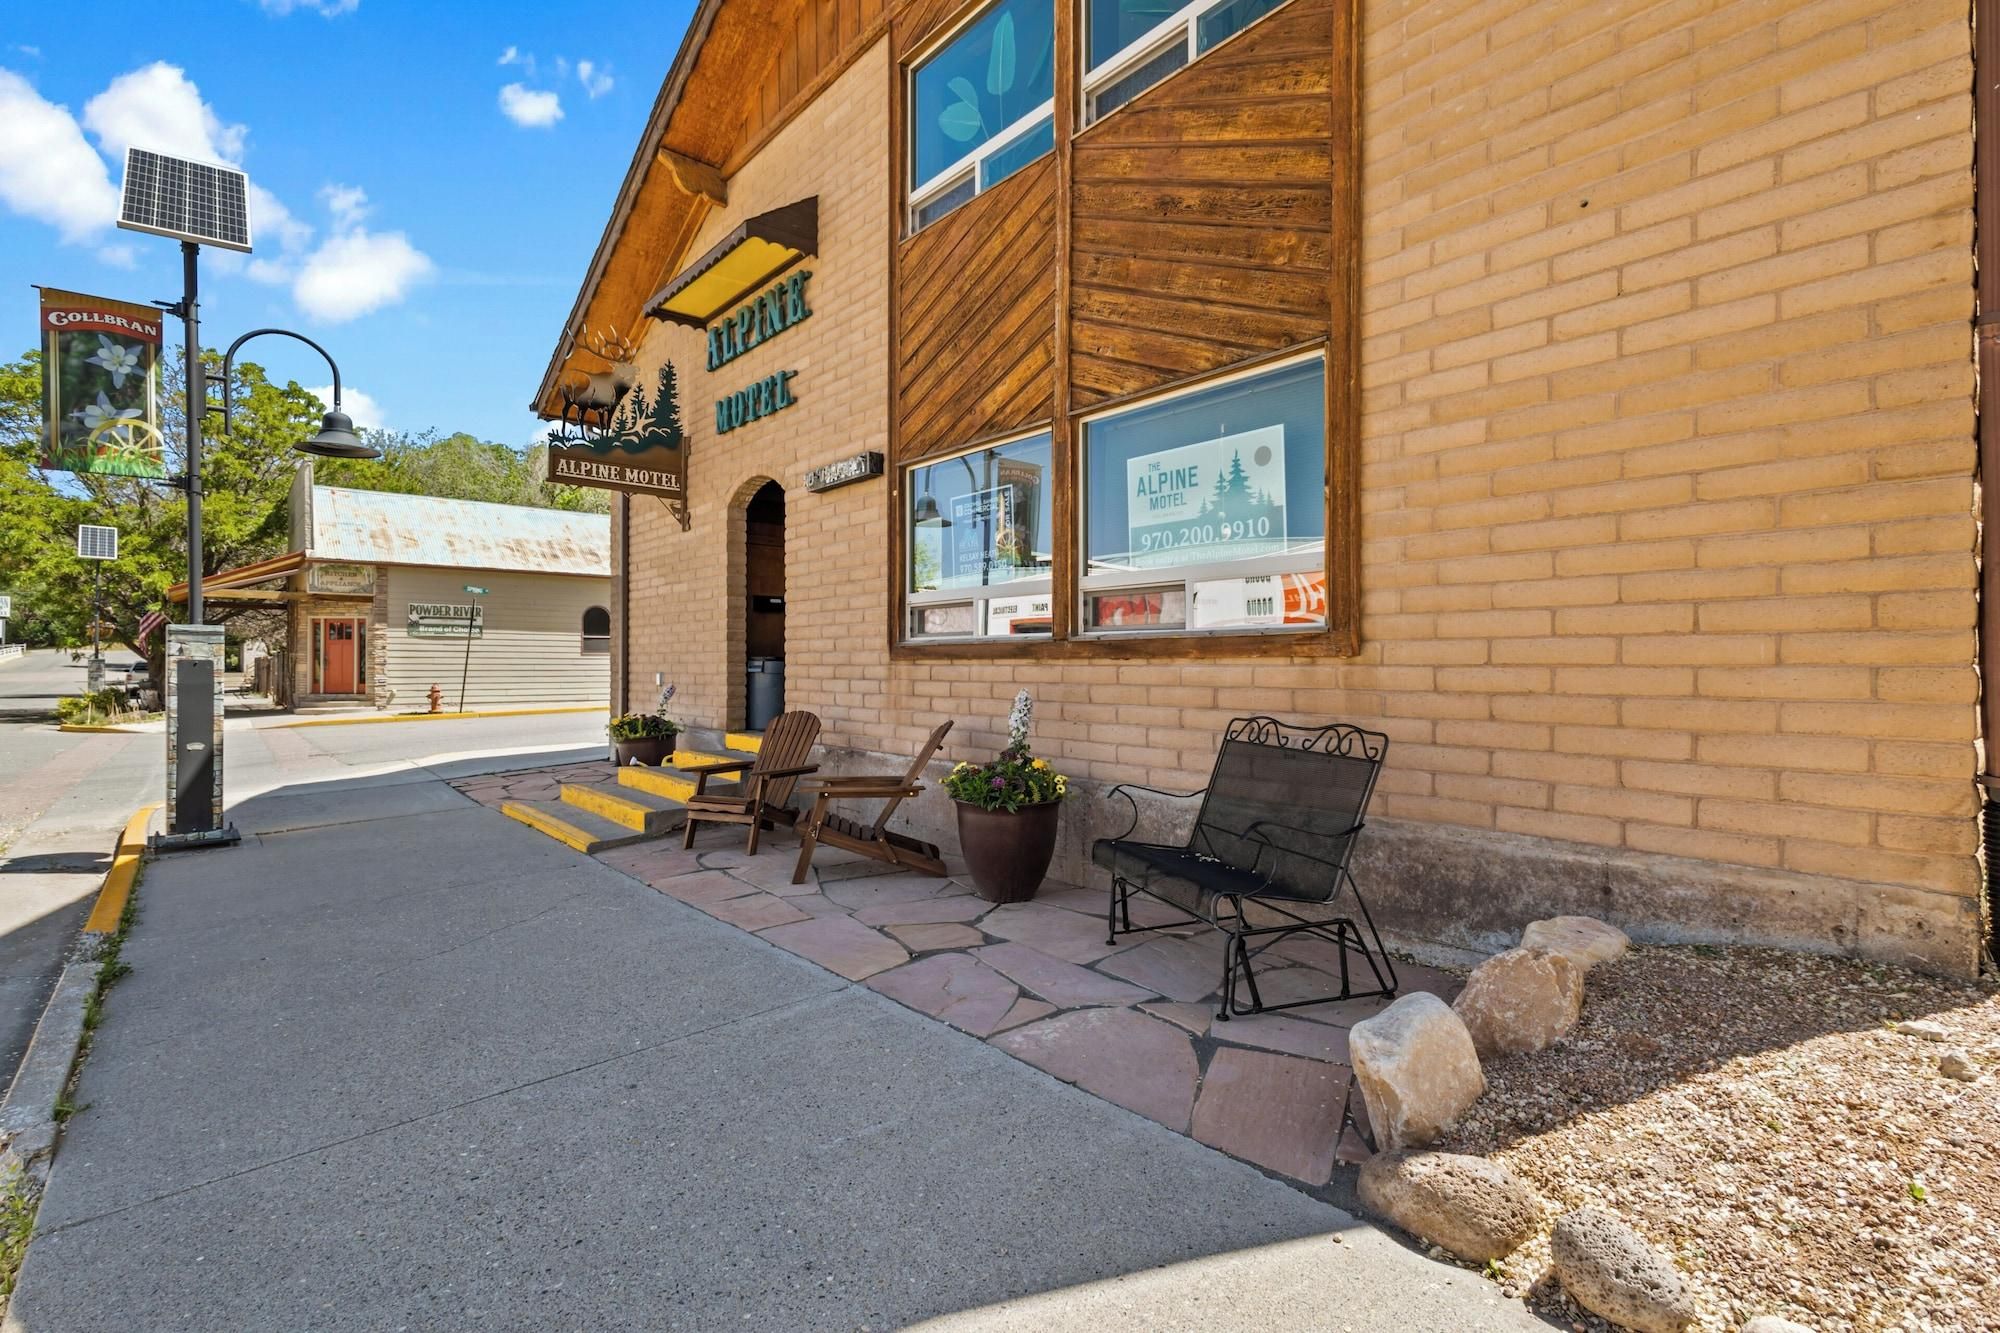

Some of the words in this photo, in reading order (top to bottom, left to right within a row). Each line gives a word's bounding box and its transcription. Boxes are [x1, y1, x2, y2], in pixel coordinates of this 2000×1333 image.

[48, 311, 157, 337] COLLBRAN
[706, 269, 813, 372] ALPINE
[715, 370, 798, 434] MOTEL
[556, 458, 620, 480] ALPINE
[625, 467, 680, 488] MOTEL
[1148, 461, 1161, 472] THE
[1137, 465, 1199, 497] ALPINE
[1149, 492, 1188, 511] MOTEL
[1141, 516, 1270, 551] 970.200.9910
[409, 604, 452, 617] POWDER
[419, 625, 443, 633] Brand
